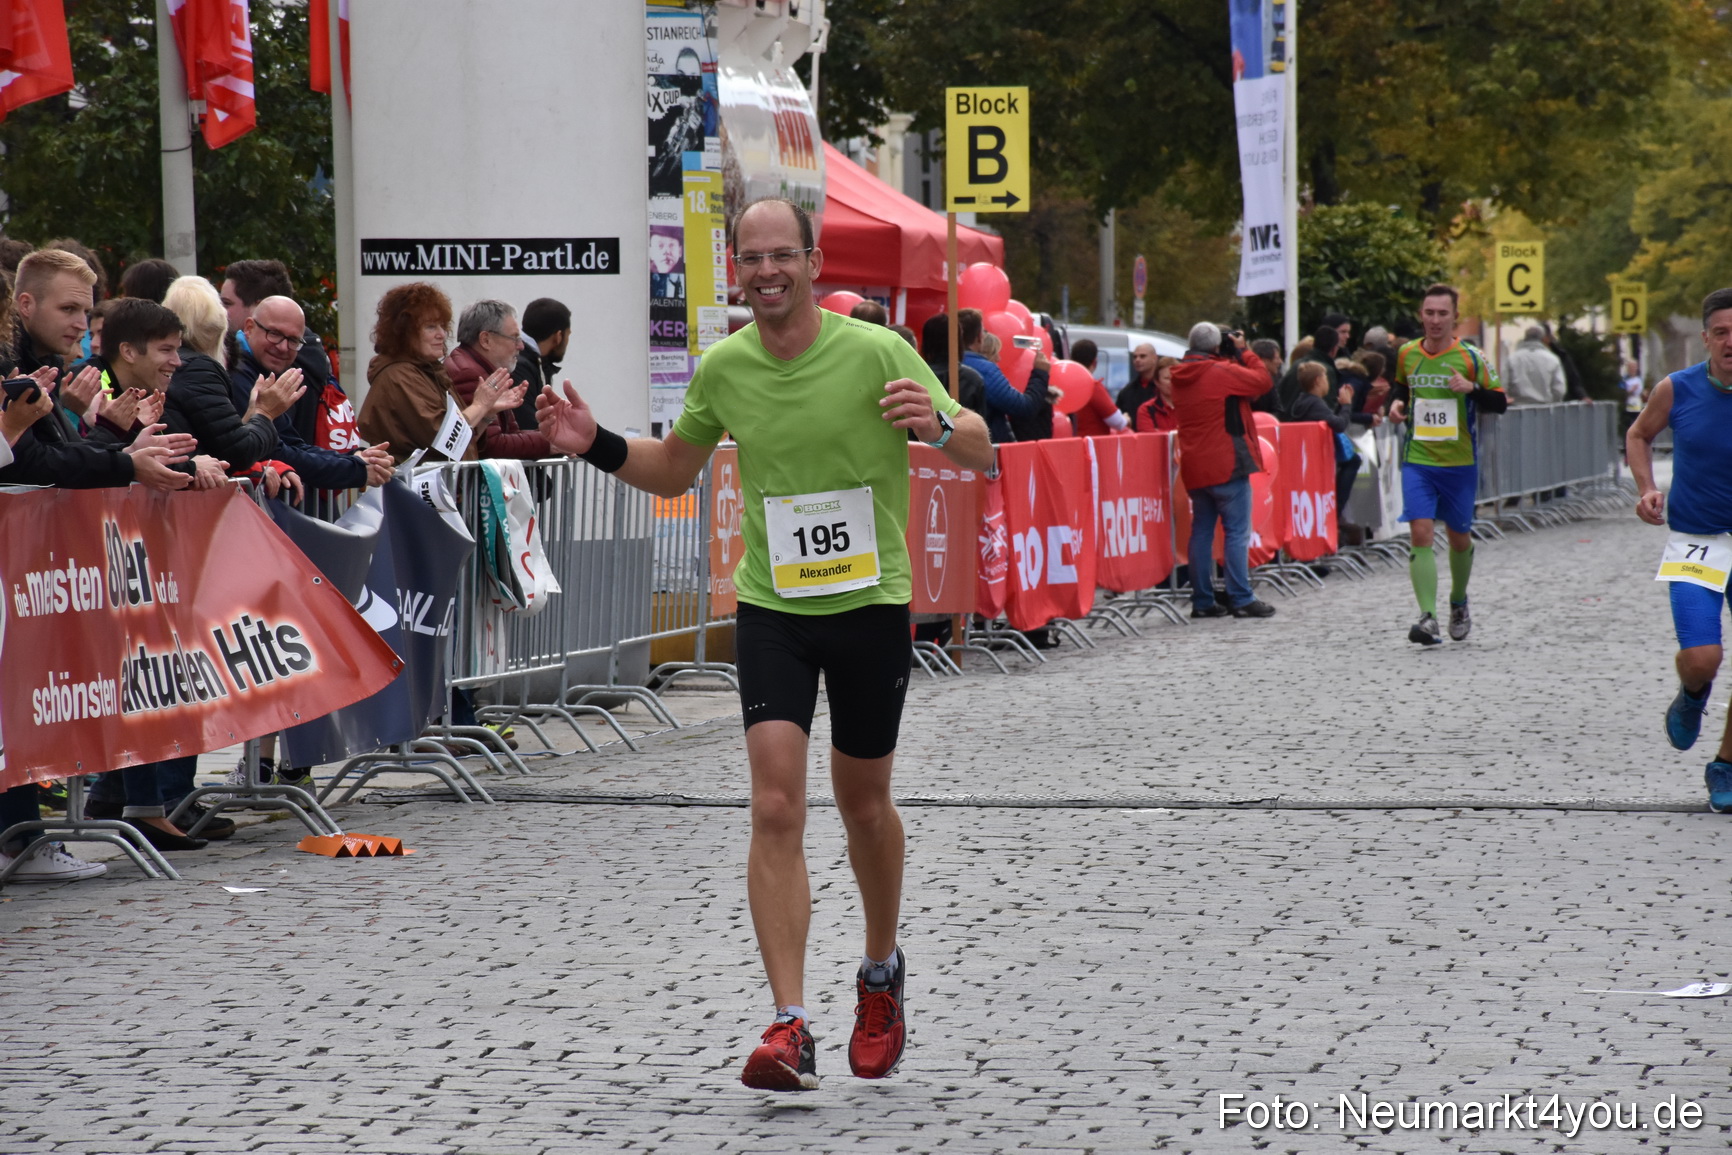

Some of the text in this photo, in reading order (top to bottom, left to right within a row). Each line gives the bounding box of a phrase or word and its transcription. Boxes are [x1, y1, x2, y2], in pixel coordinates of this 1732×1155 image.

[663, 91, 680, 105] CUP
[956, 92, 1019, 115] Block
[968, 125, 1008, 185] B
[362, 242, 610, 271] www.MINI-Partl.de
[1501, 246, 1537, 258] Block
[1507, 263, 1531, 296] C
[1621, 298, 1638, 322] D
[650, 320, 688, 337] KER
[1424, 412, 1447, 425] 418
[445, 420, 463, 451] swn
[803, 500, 841, 513] BOCK
[793, 521, 850, 557] 195
[1685, 544, 1709, 561] 71
[14, 583, 30, 617] die
[25, 552, 103, 617] meisten
[104, 519, 154, 609] 80er
[800, 563, 852, 579] Alexander
[1681, 565, 1703, 575] Stefan
[32, 670, 117, 726] schönsten
[212, 612, 313, 693] Hits
